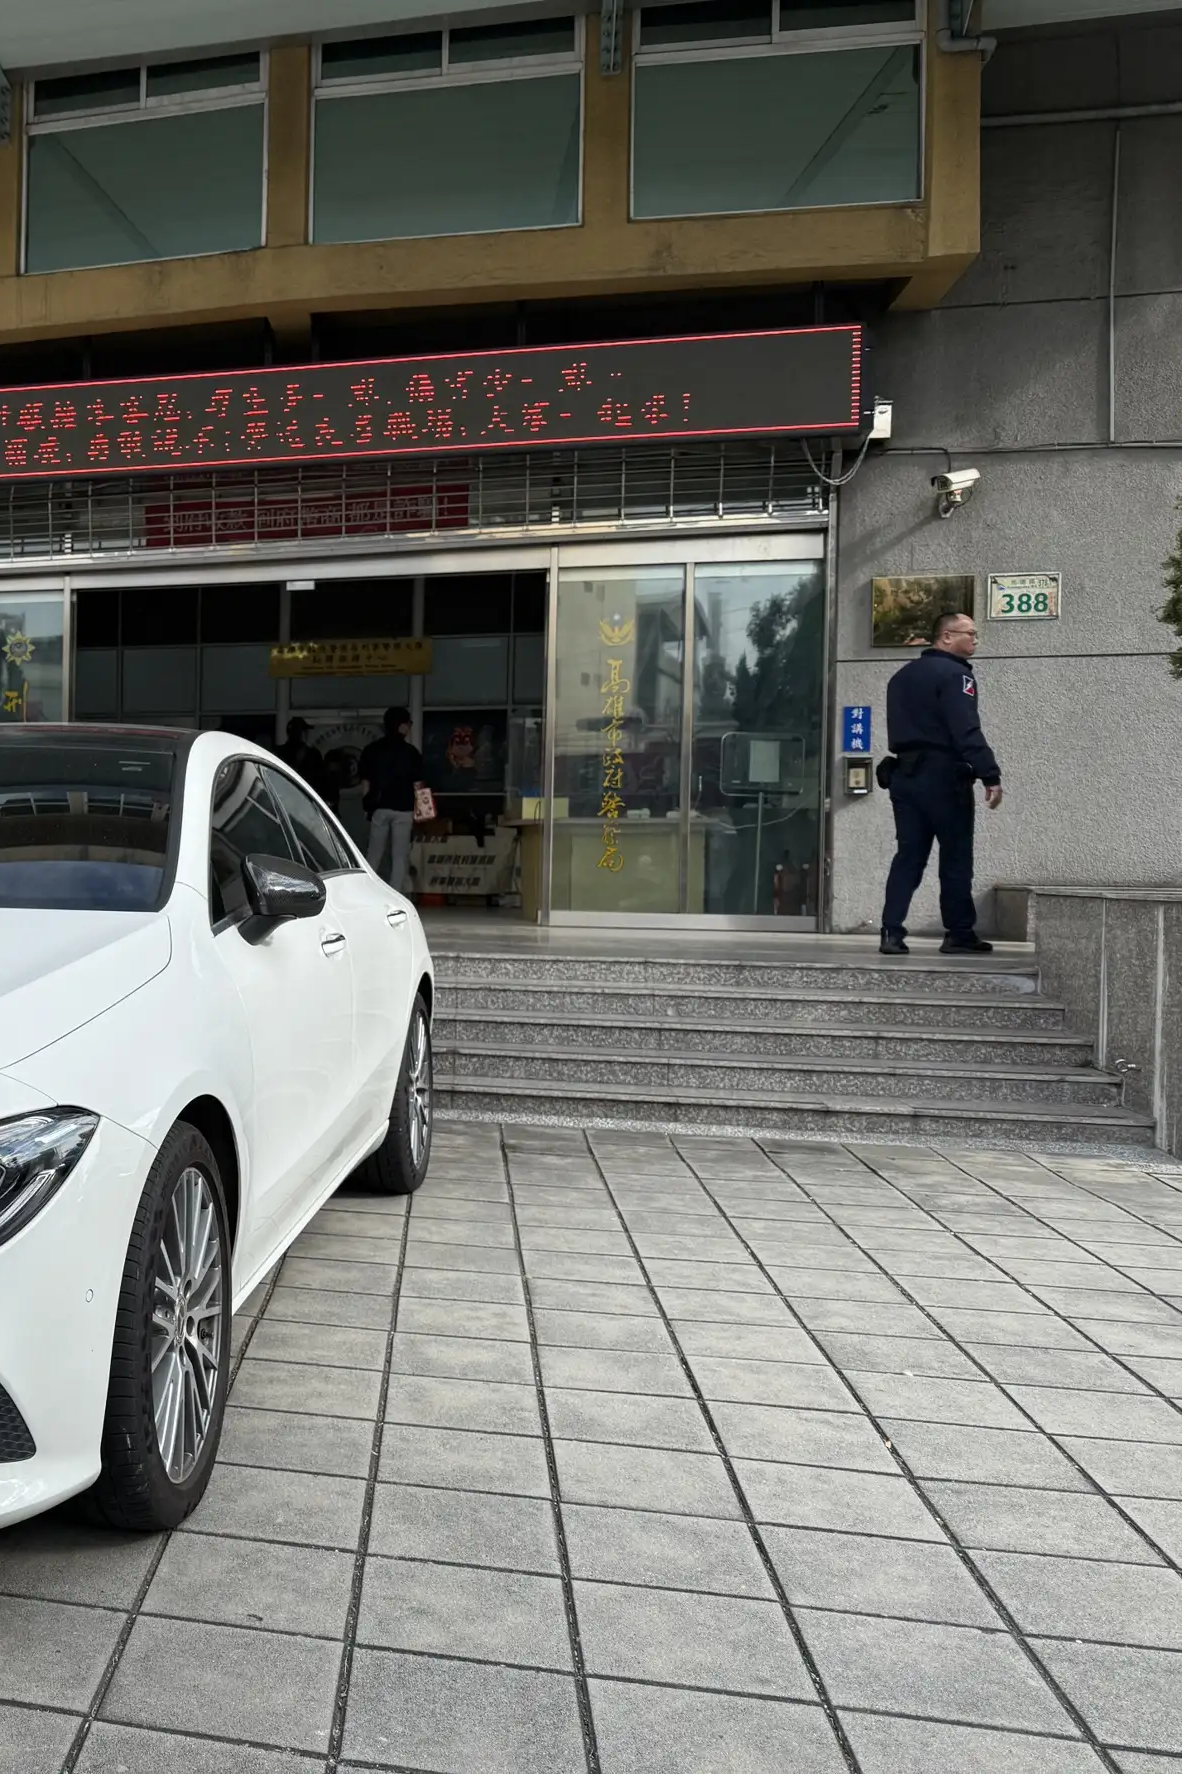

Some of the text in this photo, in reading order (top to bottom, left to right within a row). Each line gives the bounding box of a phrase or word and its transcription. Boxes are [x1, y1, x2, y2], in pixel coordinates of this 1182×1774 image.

[1001, 592, 1048, 614] 388
[851, 707, 864, 749] 對講機
